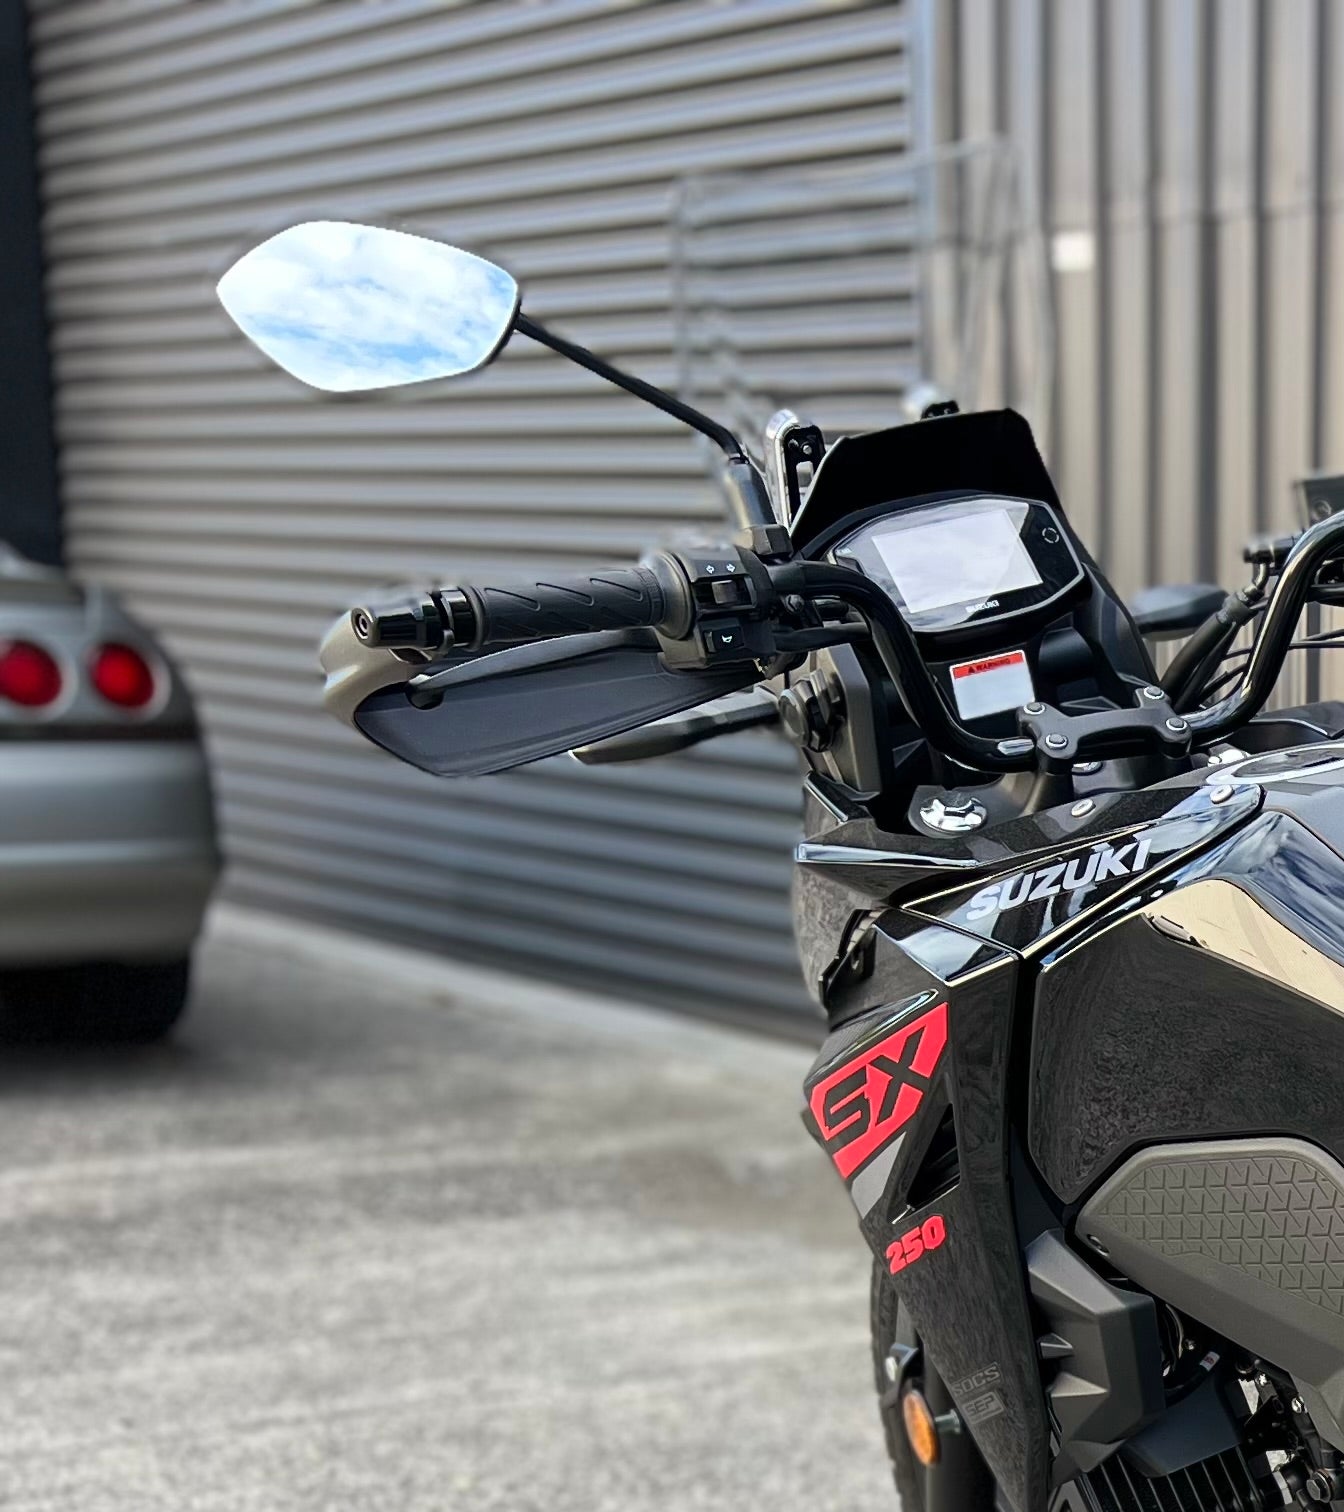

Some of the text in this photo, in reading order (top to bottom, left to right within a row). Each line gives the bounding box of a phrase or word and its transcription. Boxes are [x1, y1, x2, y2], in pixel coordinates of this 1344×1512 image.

[976, 658, 1011, 671] WARNING
[966, 838, 1152, 920] SUZUKI
[822, 1023, 932, 1156] SX
[885, 1214, 946, 1275] 250
[951, 1366, 1000, 1397] SOCS
[965, 1396, 994, 1416] SEP
